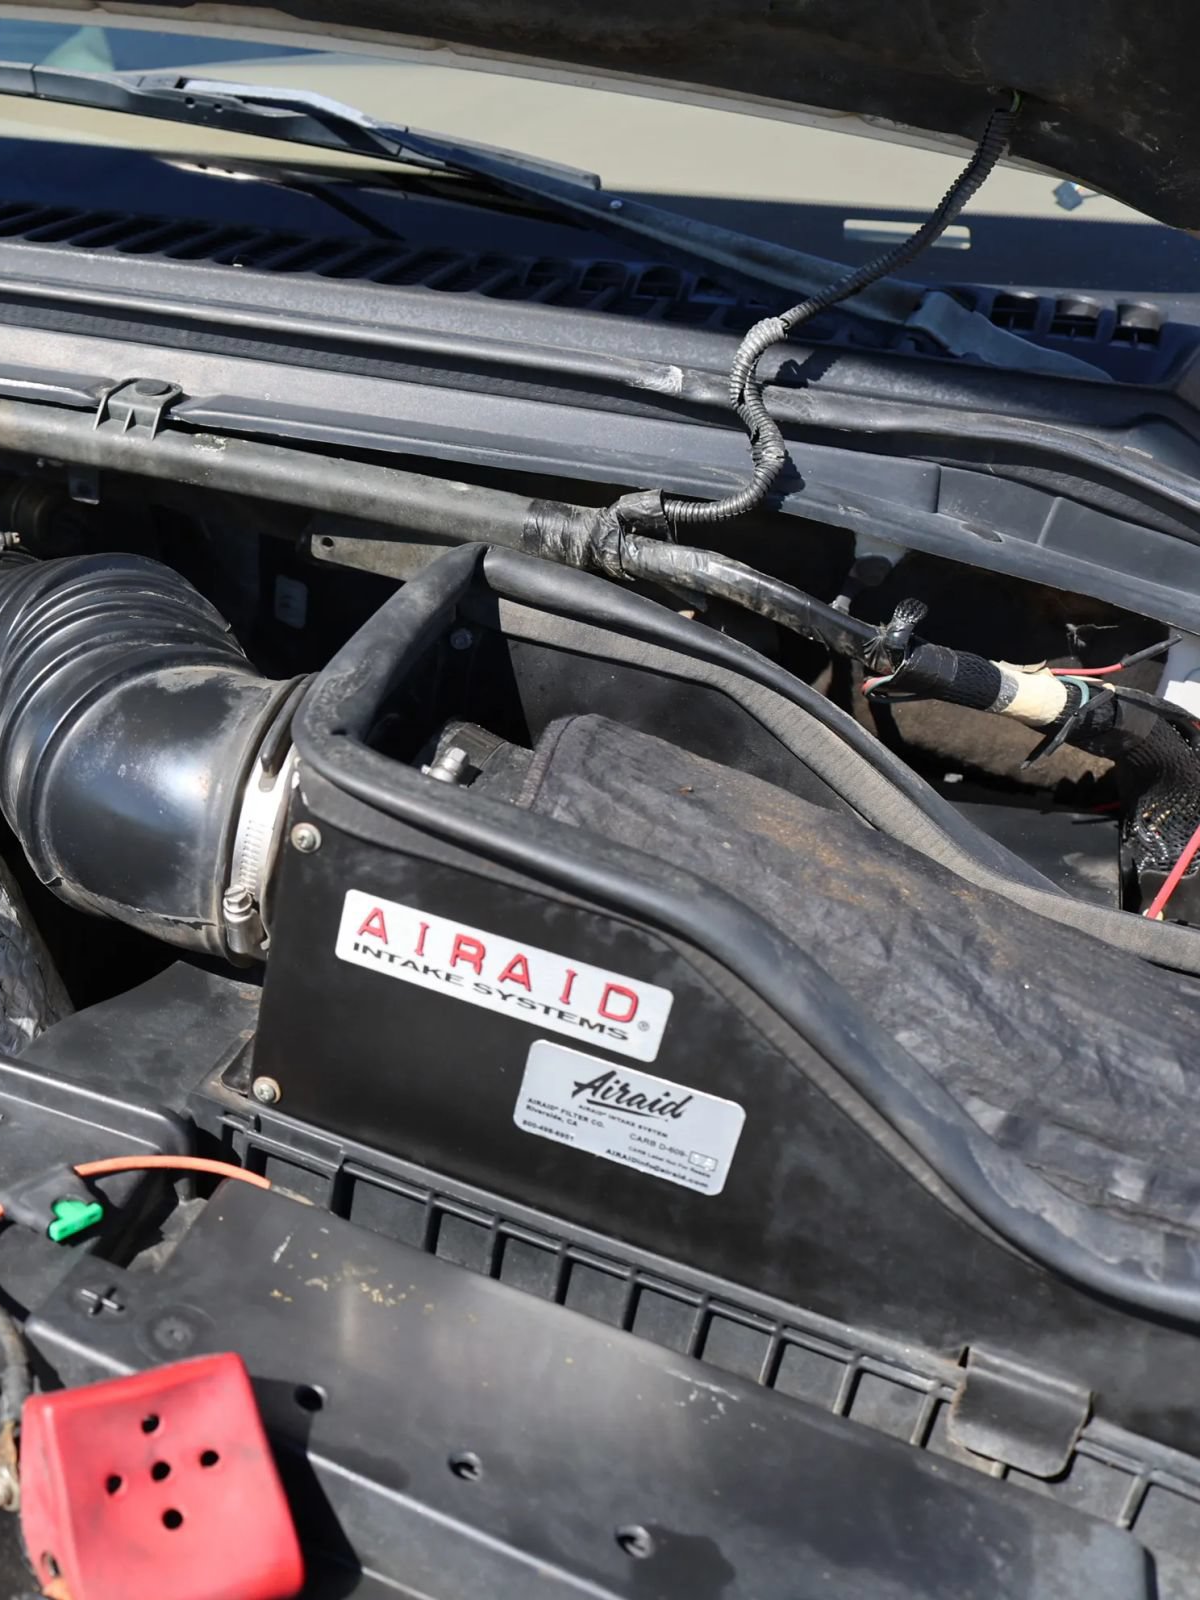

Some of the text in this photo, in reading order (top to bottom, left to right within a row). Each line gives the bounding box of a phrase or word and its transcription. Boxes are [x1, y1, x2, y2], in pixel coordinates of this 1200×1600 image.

[356, 906, 640, 1024] AIRAID
[353, 941, 629, 1042] INTAKE SYSTEMS
[571, 1069, 694, 1119] Airaid
[526, 1104, 578, 1128] Riverside, CA
[560, 1109, 589, 1122] FILTER
[629, 1132, 657, 1147] CARB
